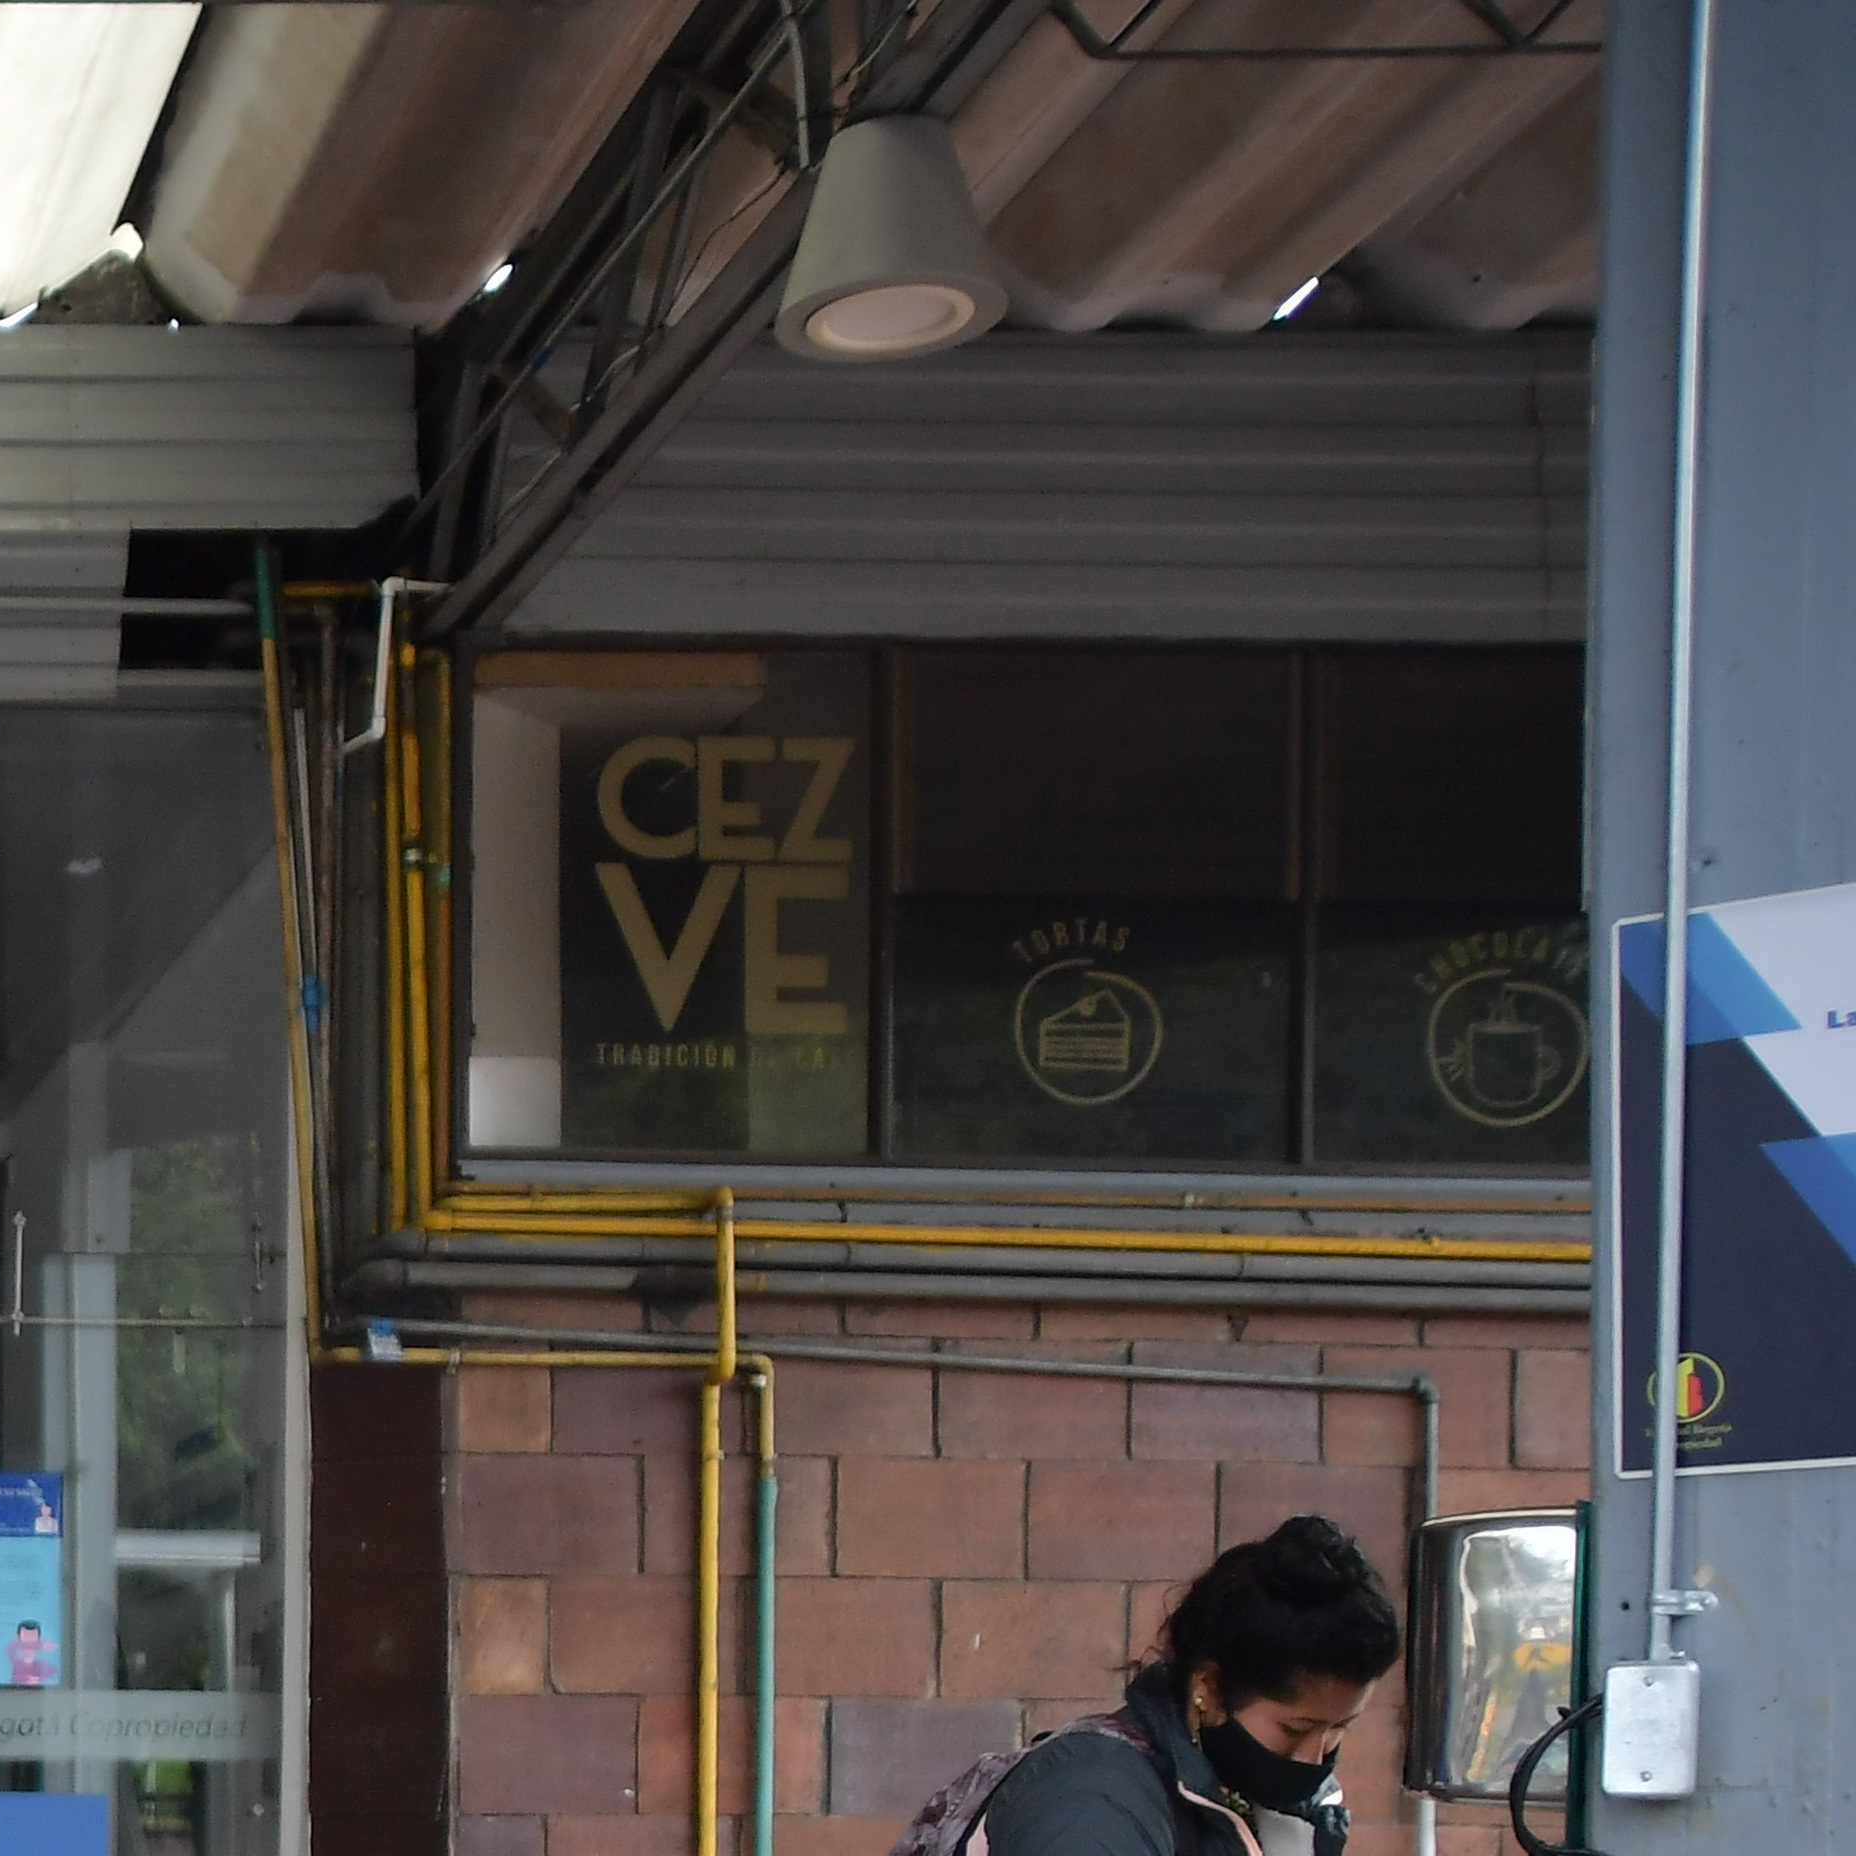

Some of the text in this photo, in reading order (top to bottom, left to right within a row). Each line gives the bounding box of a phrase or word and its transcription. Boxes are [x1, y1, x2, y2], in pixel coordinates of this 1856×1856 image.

[596, 735, 855, 862] CEZ
[595, 862, 851, 1033] VE
[1012, 917, 1131, 963] TORTAS
